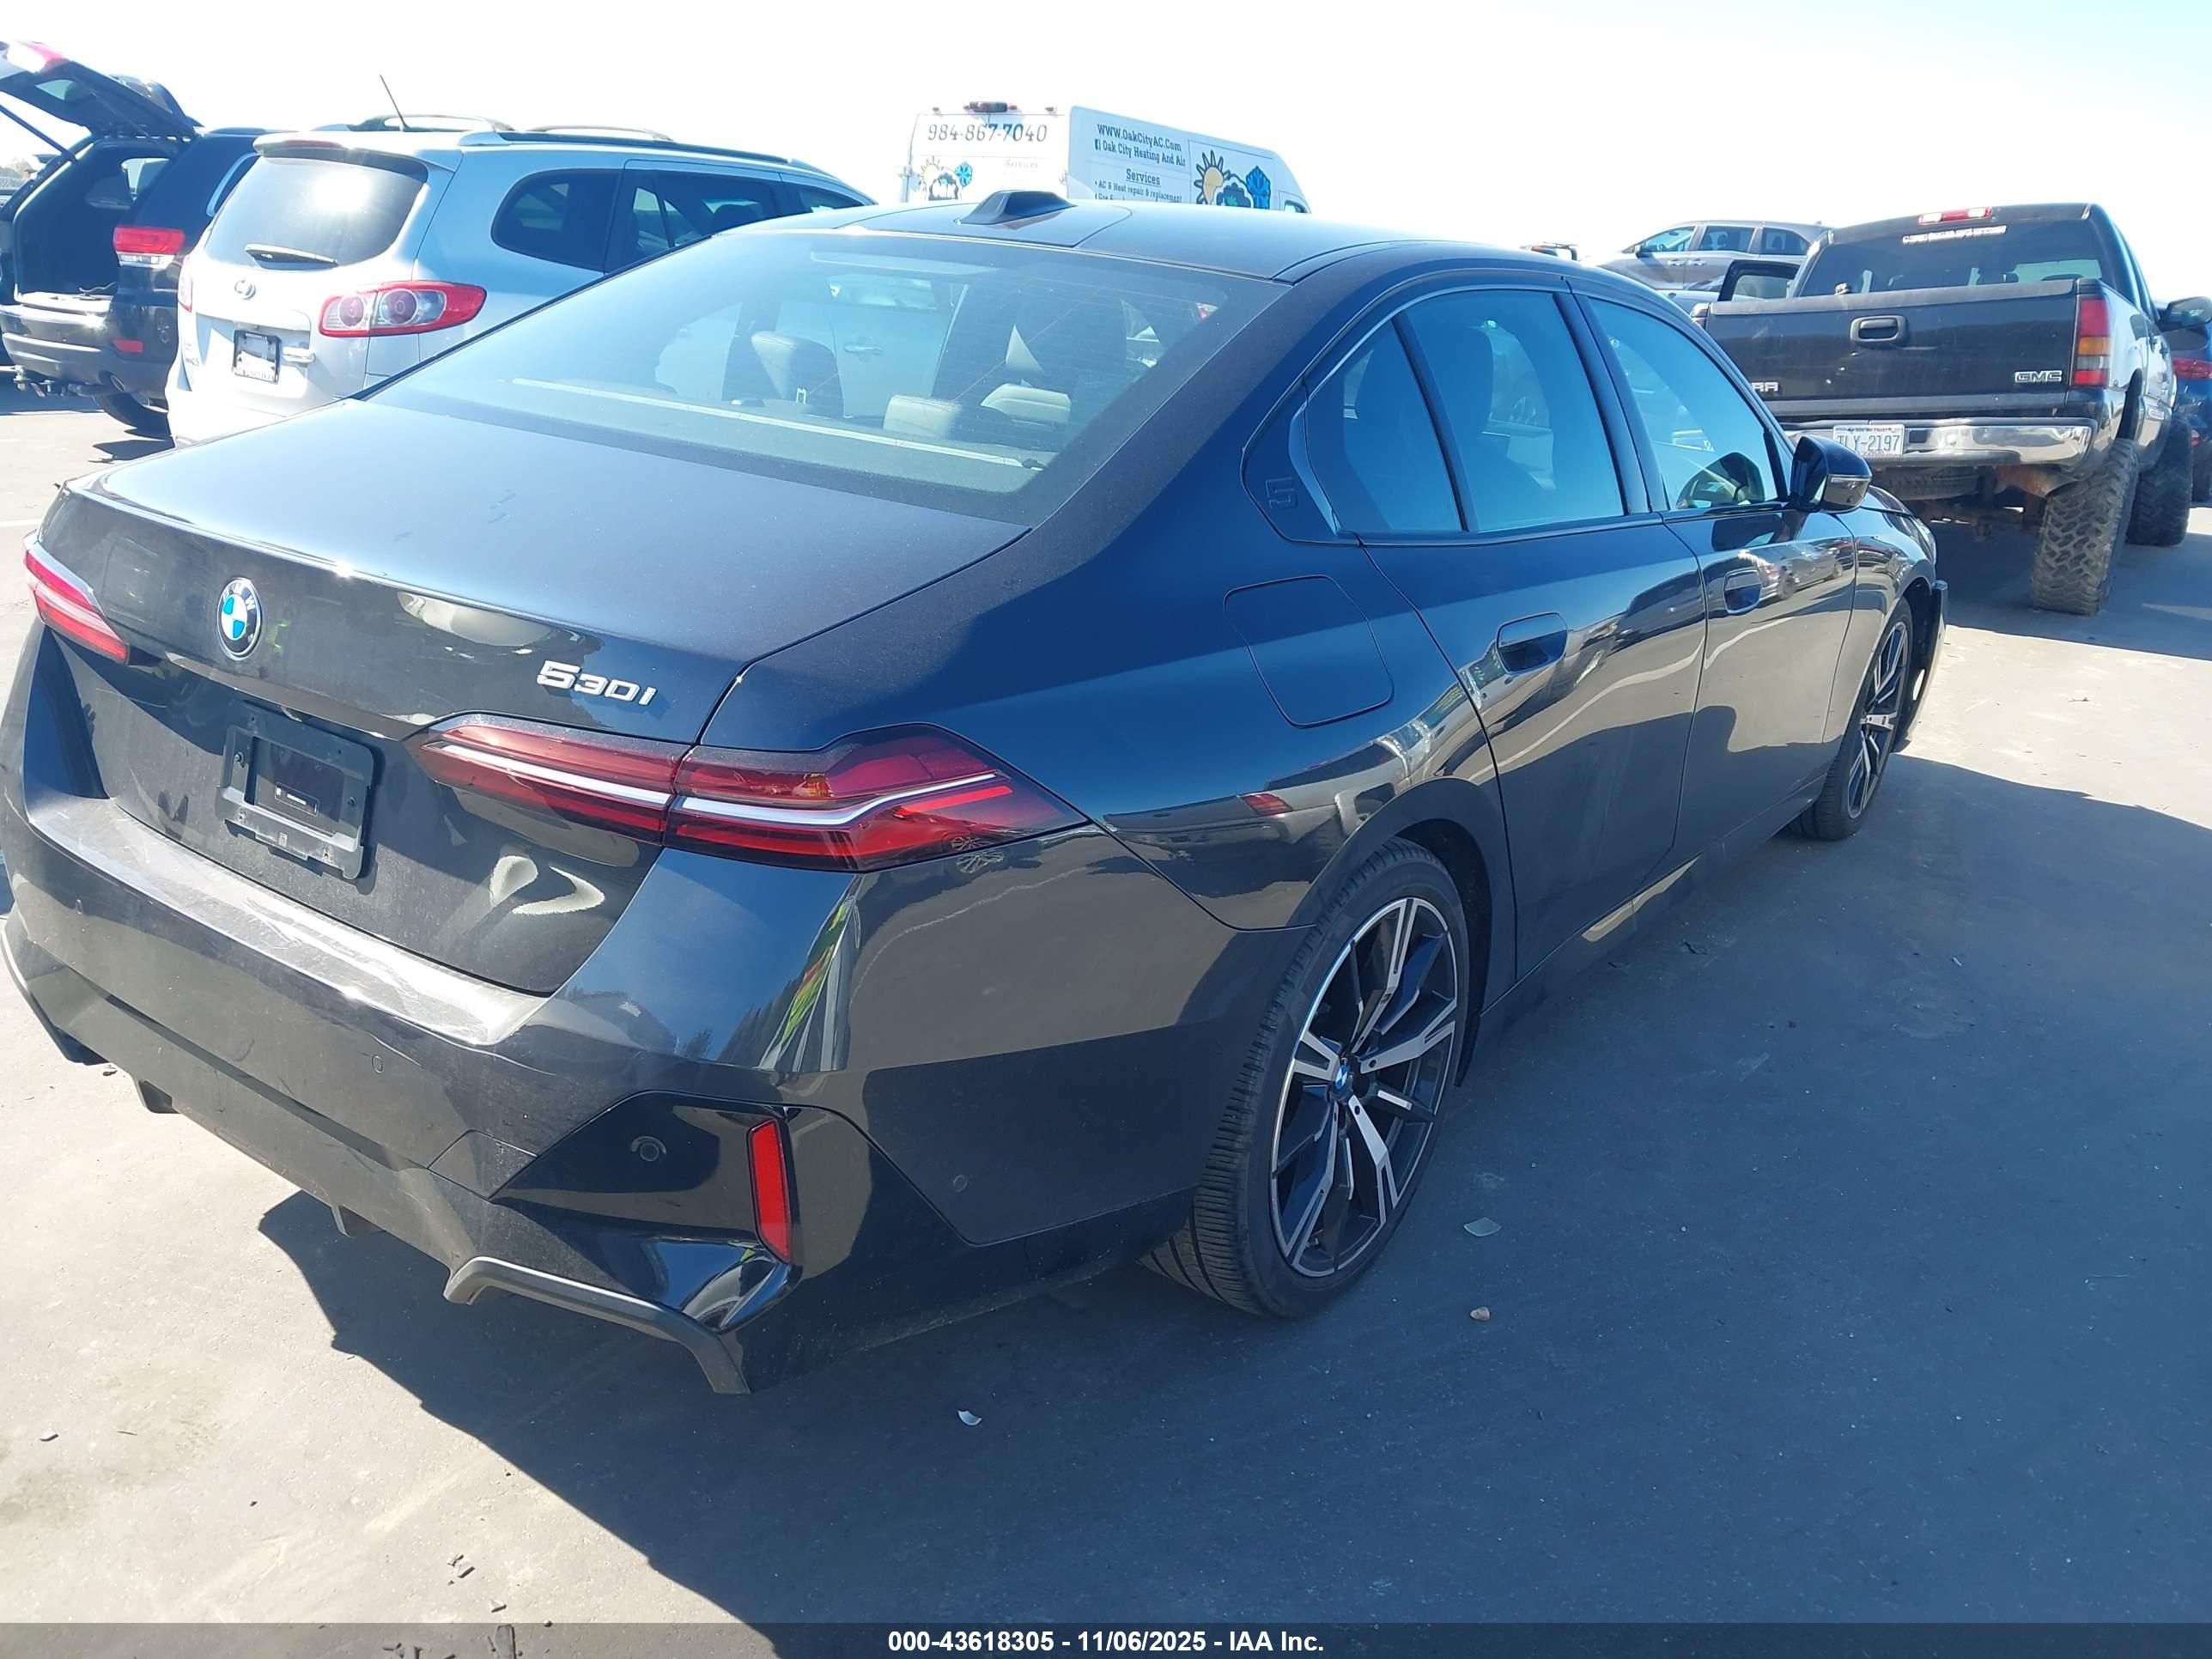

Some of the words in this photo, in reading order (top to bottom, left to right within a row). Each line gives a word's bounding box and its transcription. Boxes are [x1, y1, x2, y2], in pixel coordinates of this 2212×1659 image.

[927, 123, 1048, 143] 984-867-7040
[1097, 124, 1182, 151] WWW.OakCityAC.Com
[1103, 140, 1116, 153] Oak
[1118, 143, 1133, 158] City
[1133, 146, 1160, 164] Heating
[1162, 152, 1175, 165] And
[1176, 155, 1186, 167] Air
[1126, 168, 1161, 185] Services
[1099, 180, 1107, 189] AC
[1114, 183, 1127, 193] Heat
[1127, 185, 1145, 197] repair
[2014, 370, 2063, 383] GMC
